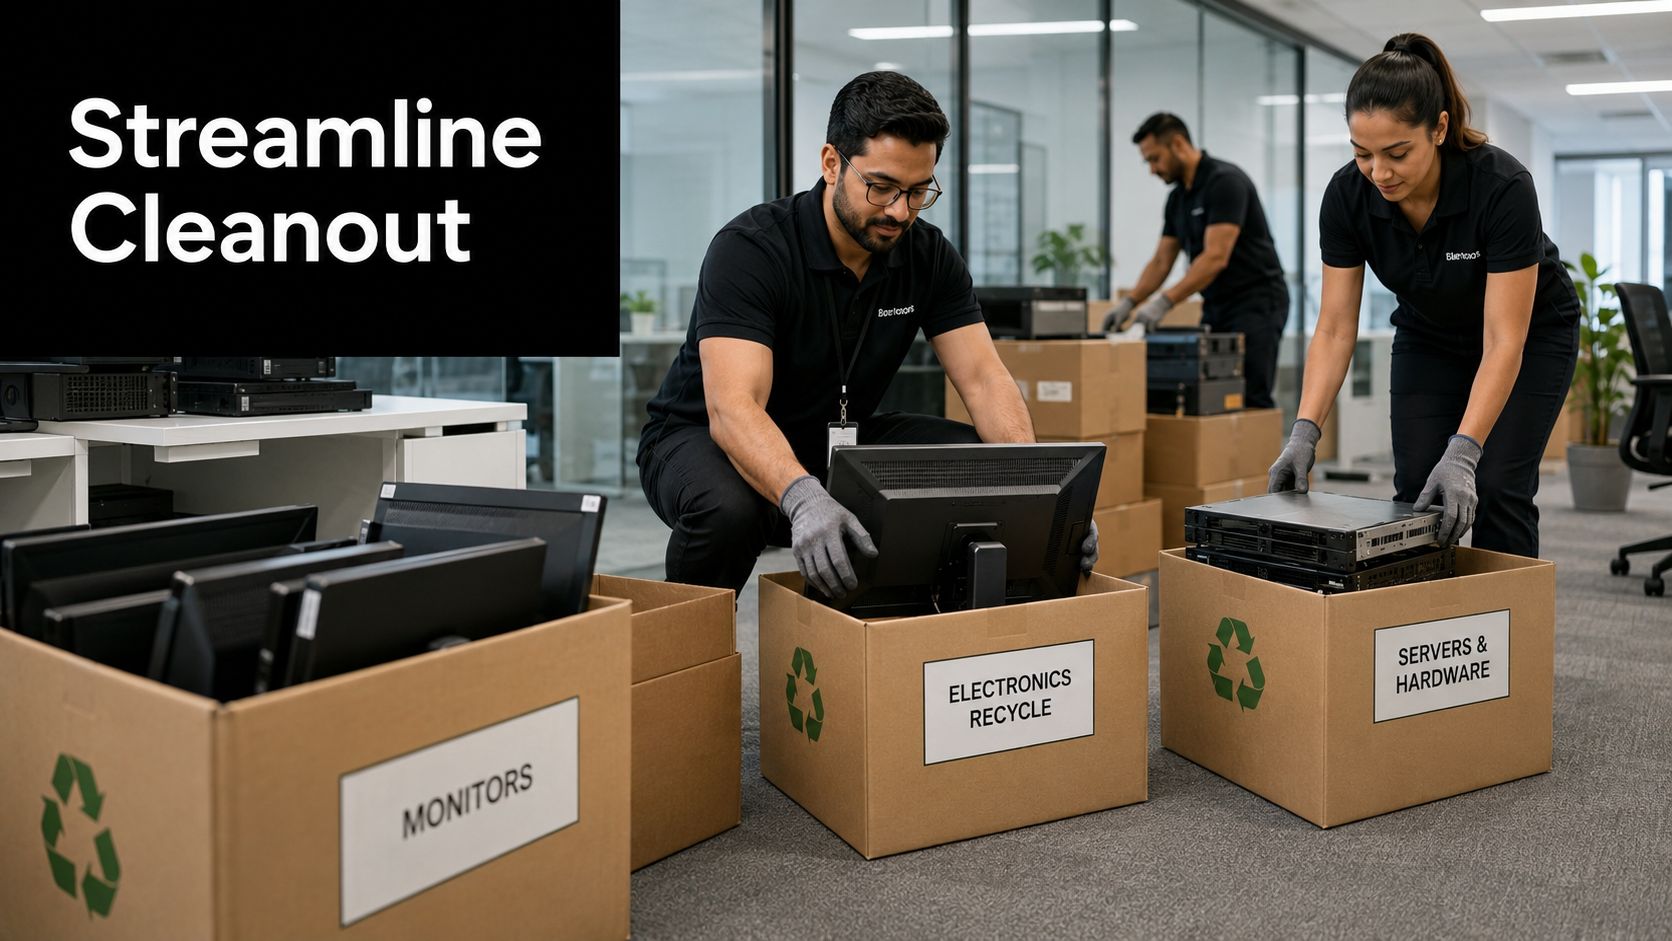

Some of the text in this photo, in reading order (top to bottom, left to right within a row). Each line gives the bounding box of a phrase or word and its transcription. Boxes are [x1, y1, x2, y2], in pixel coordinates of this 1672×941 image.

[1398, 635, 1488, 667] SERVERS &
[949, 668, 1072, 704] ELECTRONICS
[1396, 659, 1491, 695] HARDWARE
[970, 698, 1052, 729] RECYCLE
[403, 763, 533, 838] MONITORS
